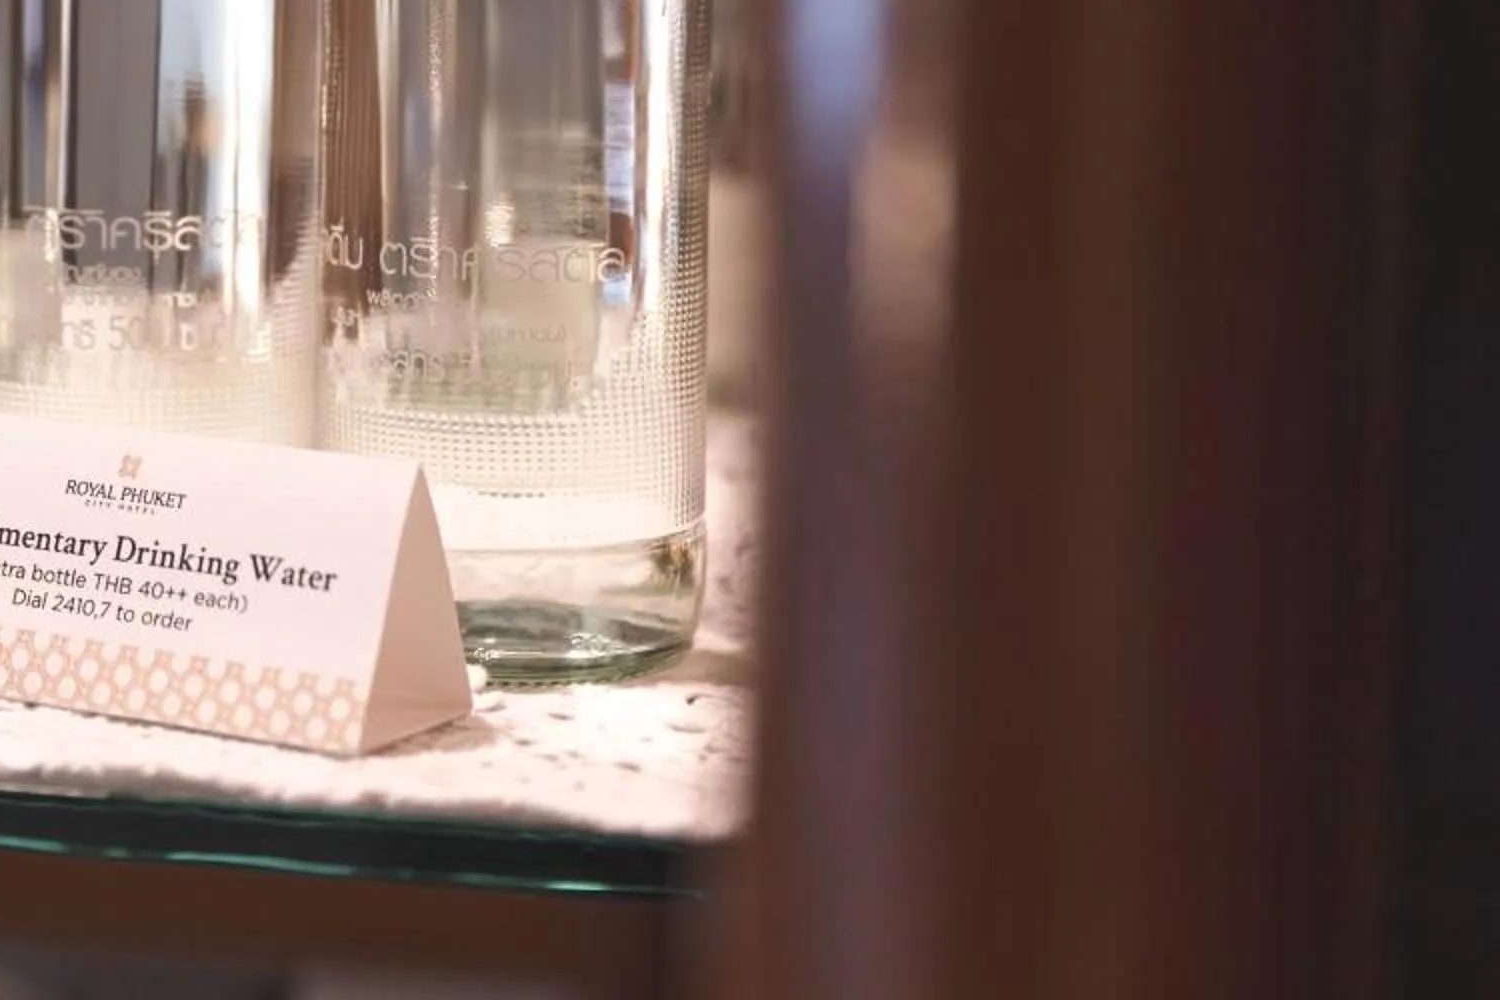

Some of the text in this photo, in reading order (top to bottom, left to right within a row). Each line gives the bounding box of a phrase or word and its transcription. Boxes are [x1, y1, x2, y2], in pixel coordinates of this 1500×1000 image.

[64, 478, 188, 510] ROYAL PHUKET
[112, 534, 241, 587] Drinking
[249, 553, 338, 592] Water
[11, 587, 193, 632] Dial 2410,7 to order
[30, 563, 87, 589] bottle
[93, 572, 133, 595] THB
[137, 580, 188, 601] 40++
[193, 591, 249, 614] each)
